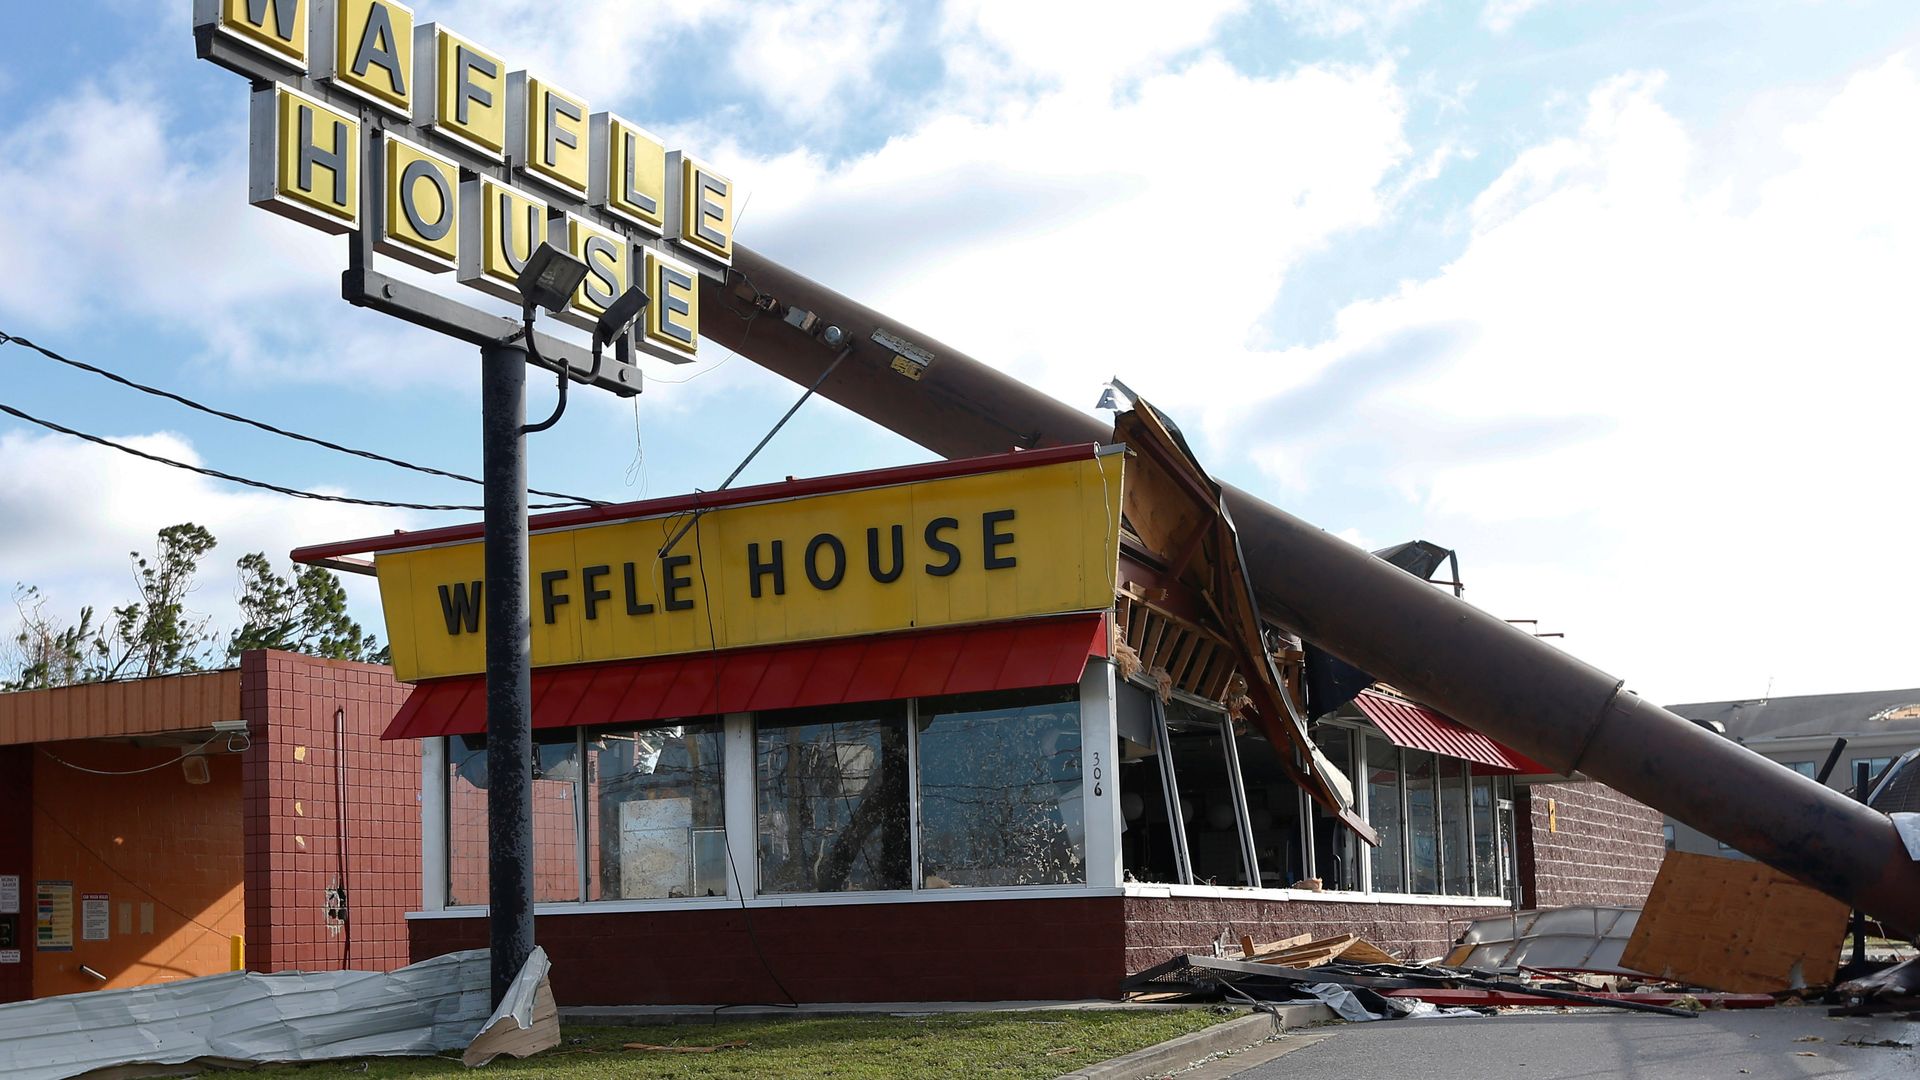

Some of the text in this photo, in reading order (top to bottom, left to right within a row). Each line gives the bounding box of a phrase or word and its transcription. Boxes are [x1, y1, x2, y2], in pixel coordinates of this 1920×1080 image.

[298, 104, 693, 344] HOUSE
[437, 508, 1017, 636] WFFLE HOUSE
[1092, 751, 1103, 797] 306
